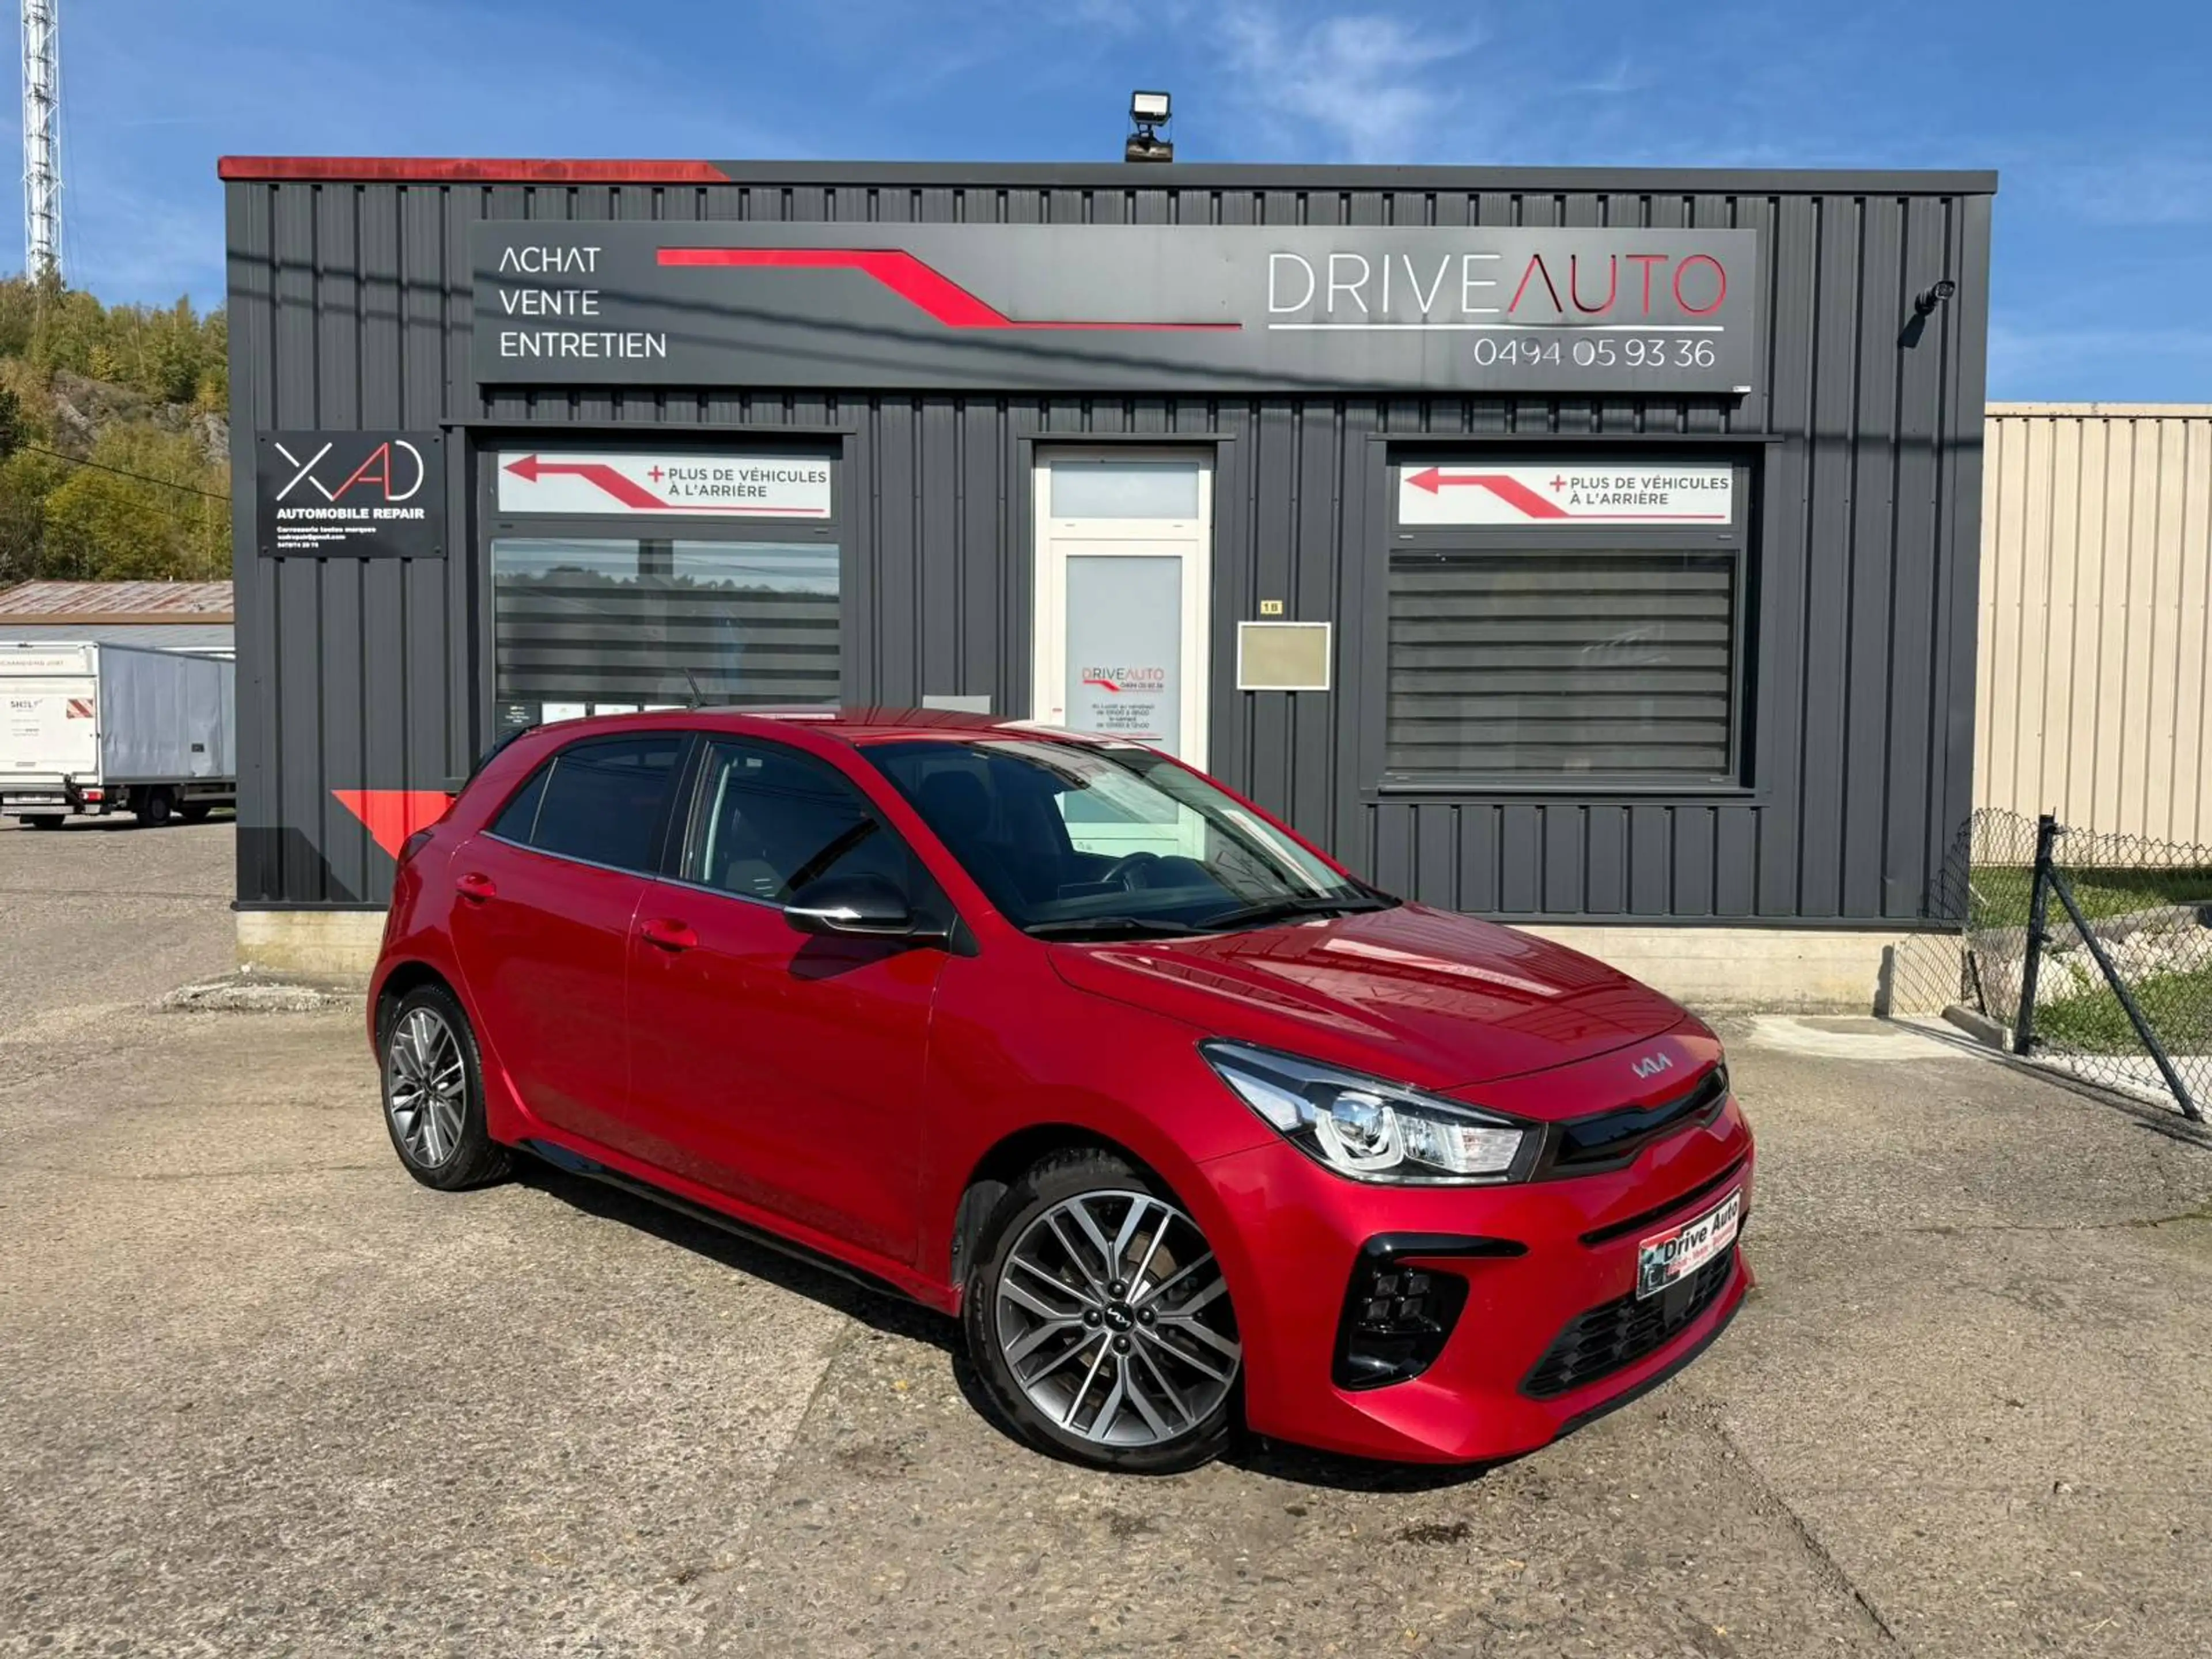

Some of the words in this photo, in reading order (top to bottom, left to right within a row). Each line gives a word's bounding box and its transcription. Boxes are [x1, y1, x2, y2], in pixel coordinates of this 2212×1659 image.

[498, 247, 601, 273] ACHAT
[1268, 253, 1726, 313] DRIVEAUTO
[499, 290, 600, 316] VENTE
[500, 332, 666, 358] ENTRETIEN
[1474, 338, 1560, 366] 0494
[1573, 338, 1616, 366] 05
[1624, 339, 1665, 367] 93
[1673, 339, 1716, 368] 36
[274, 440, 424, 502] XAD
[668, 468, 708, 480] PLUS
[713, 469, 734, 481] DE
[738, 467, 827, 483] VÉHICULES
[1570, 477, 1610, 489] PLUS
[1615, 478, 1636, 489] DE
[1641, 474, 1729, 490] VÉHICULES
[668, 481, 680, 495] À
[685, 482, 767, 498] L'ARRIÈRE
[1570, 490, 1581, 505] À
[1586, 490, 1668, 505] L'ARRIÈRE
[276, 508, 370, 520] AUTOMOBILE
[373, 508, 425, 520] REPAIR
[1082, 667, 1164, 680] DRIVEAUTO
[1664, 1226, 1707, 1263] Drive
[1711, 1200, 1737, 1235] Auto
